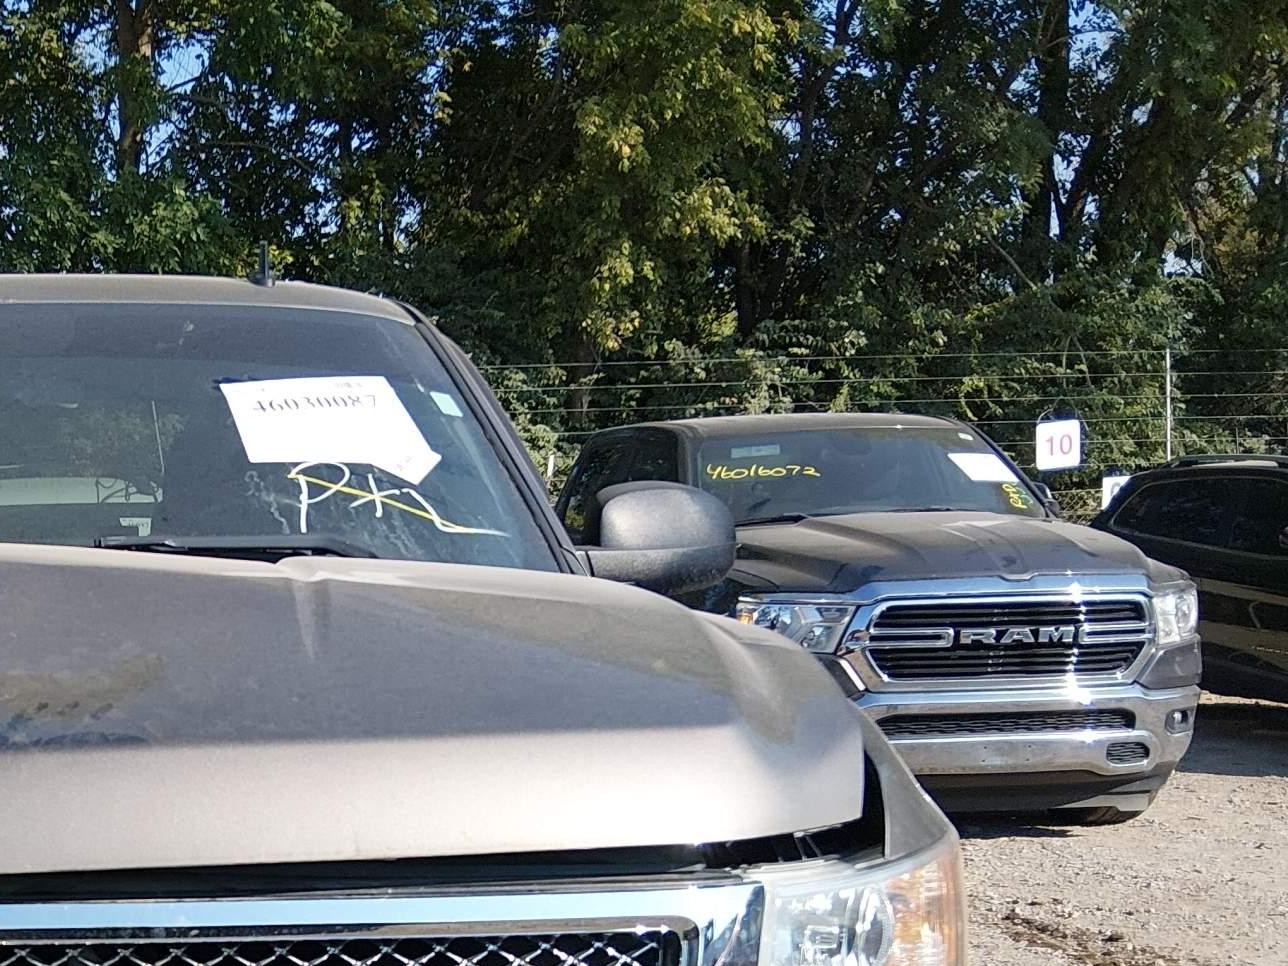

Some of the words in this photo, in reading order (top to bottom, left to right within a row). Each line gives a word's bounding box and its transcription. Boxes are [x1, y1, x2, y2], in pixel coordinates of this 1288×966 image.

[1045, 434, 1073, 456] 10
[706, 464, 822, 480] 46016072
[959, 625, 1076, 645] RAM
